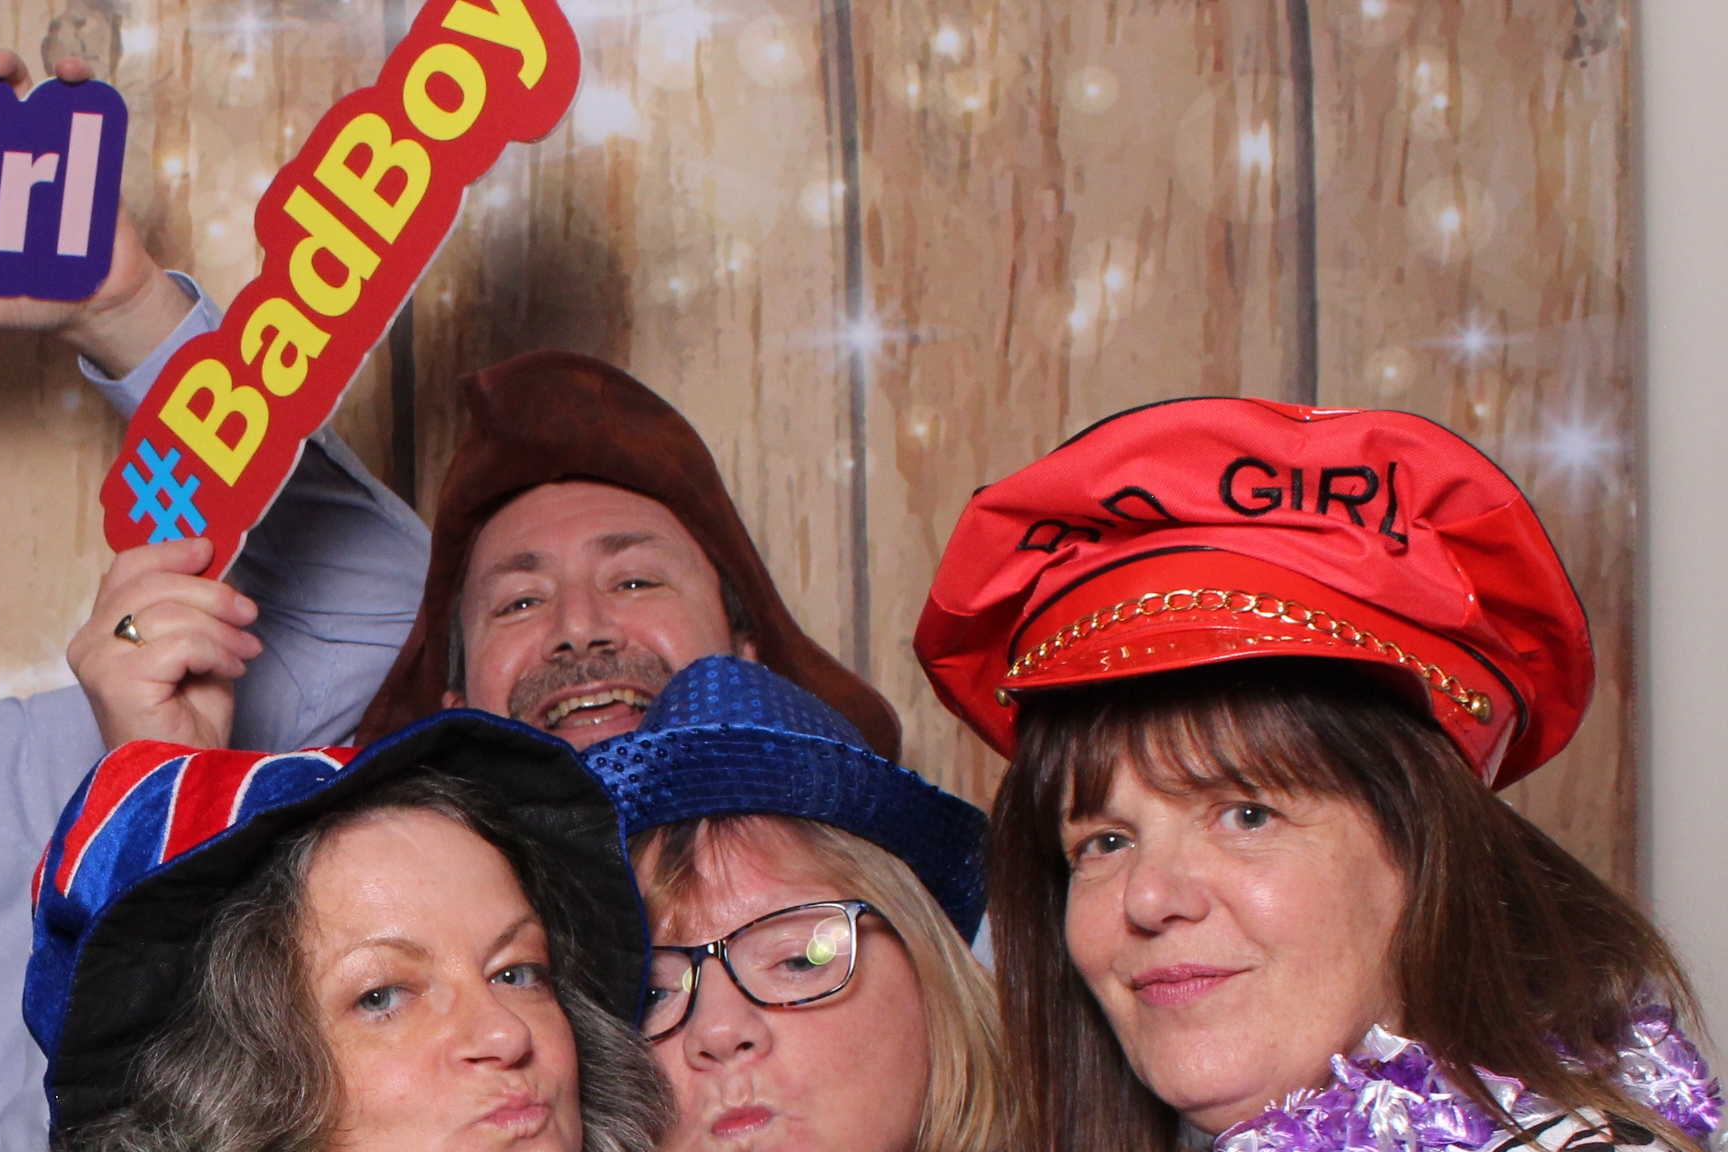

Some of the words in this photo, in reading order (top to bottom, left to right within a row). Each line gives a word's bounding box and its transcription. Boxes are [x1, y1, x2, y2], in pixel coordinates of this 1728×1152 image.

[122, 0, 548, 543] #BadBoy
[1015, 485, 1181, 554] BD
[1219, 455, 1409, 545] GIRL
